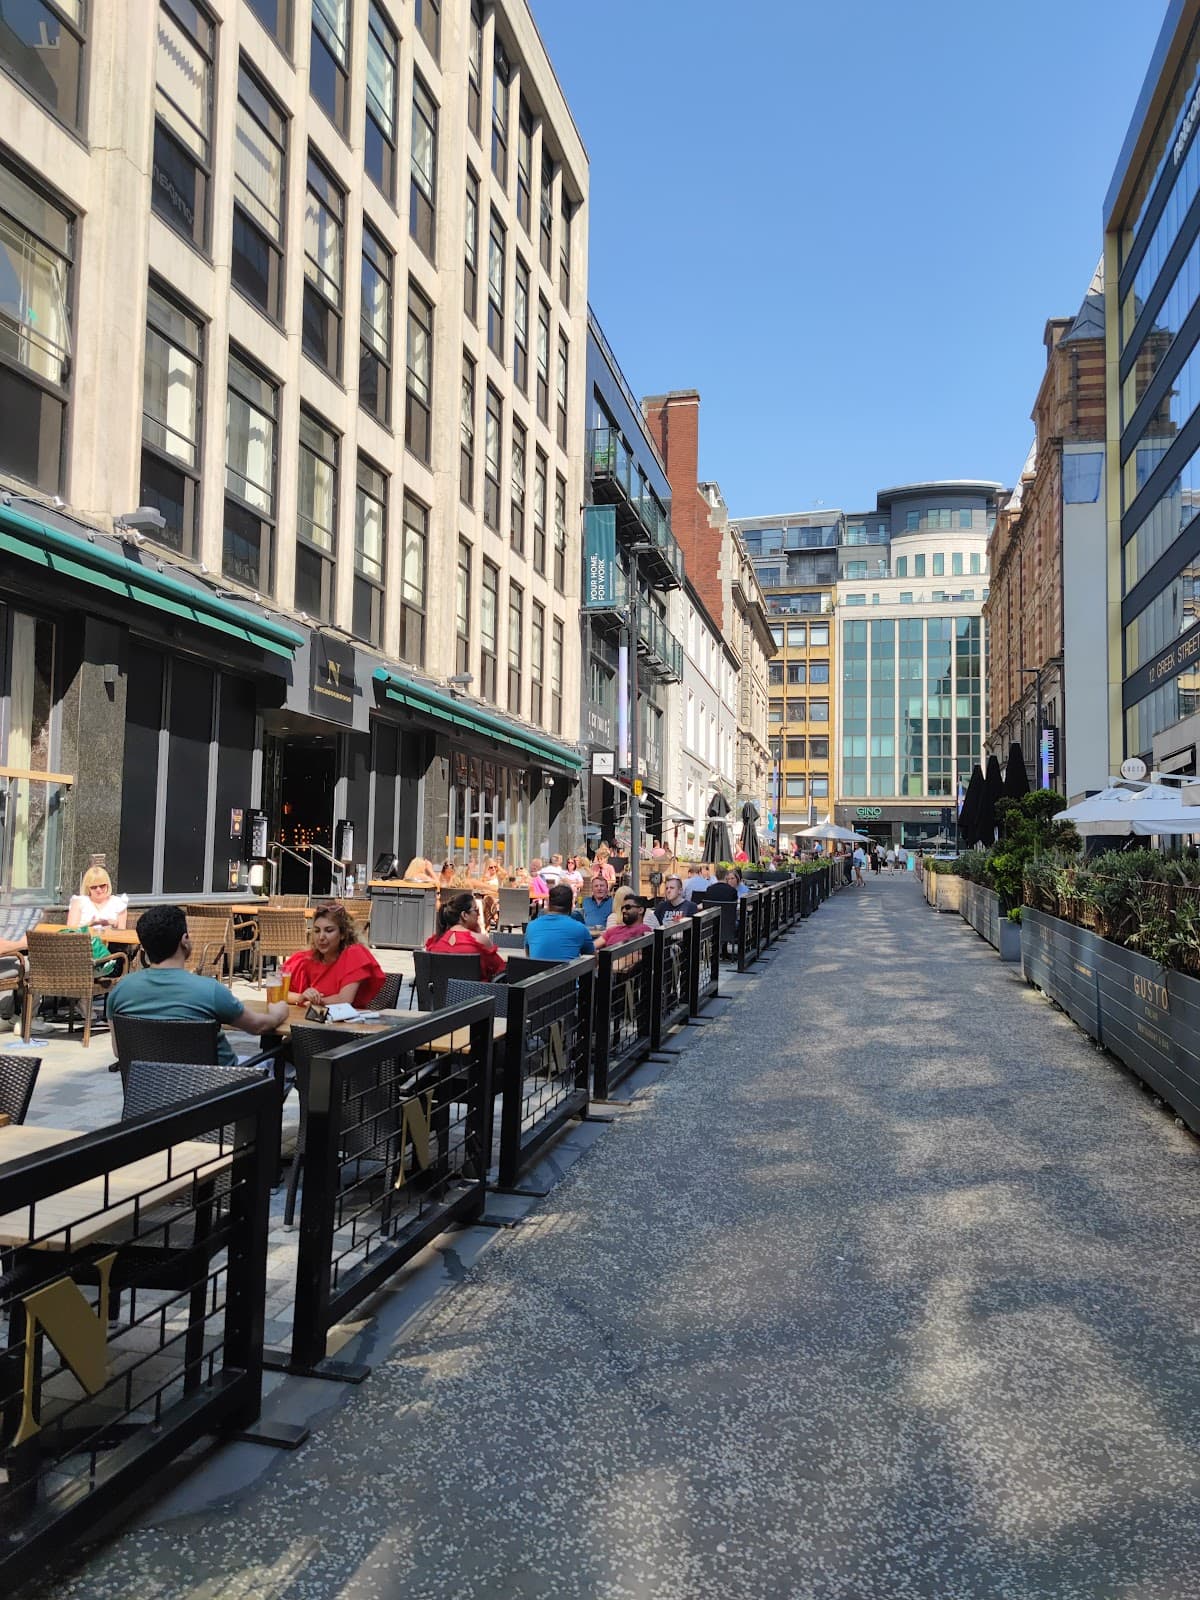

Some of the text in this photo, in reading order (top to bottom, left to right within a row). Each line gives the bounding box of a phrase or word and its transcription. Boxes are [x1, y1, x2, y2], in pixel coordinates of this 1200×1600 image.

[590, 580, 598, 601] YOUR
[598, 559, 606, 601] FOR WORK
[326, 659, 341, 688] N
[1149, 631, 1200, 684] 12 GREEK STREET
[856, 806, 882, 816] GINO
[1134, 975, 1169, 1010] GUSTO
[546, 1017, 568, 1083] N
[394, 1088, 435, 1190] N
[12, 1251, 119, 1448] N
